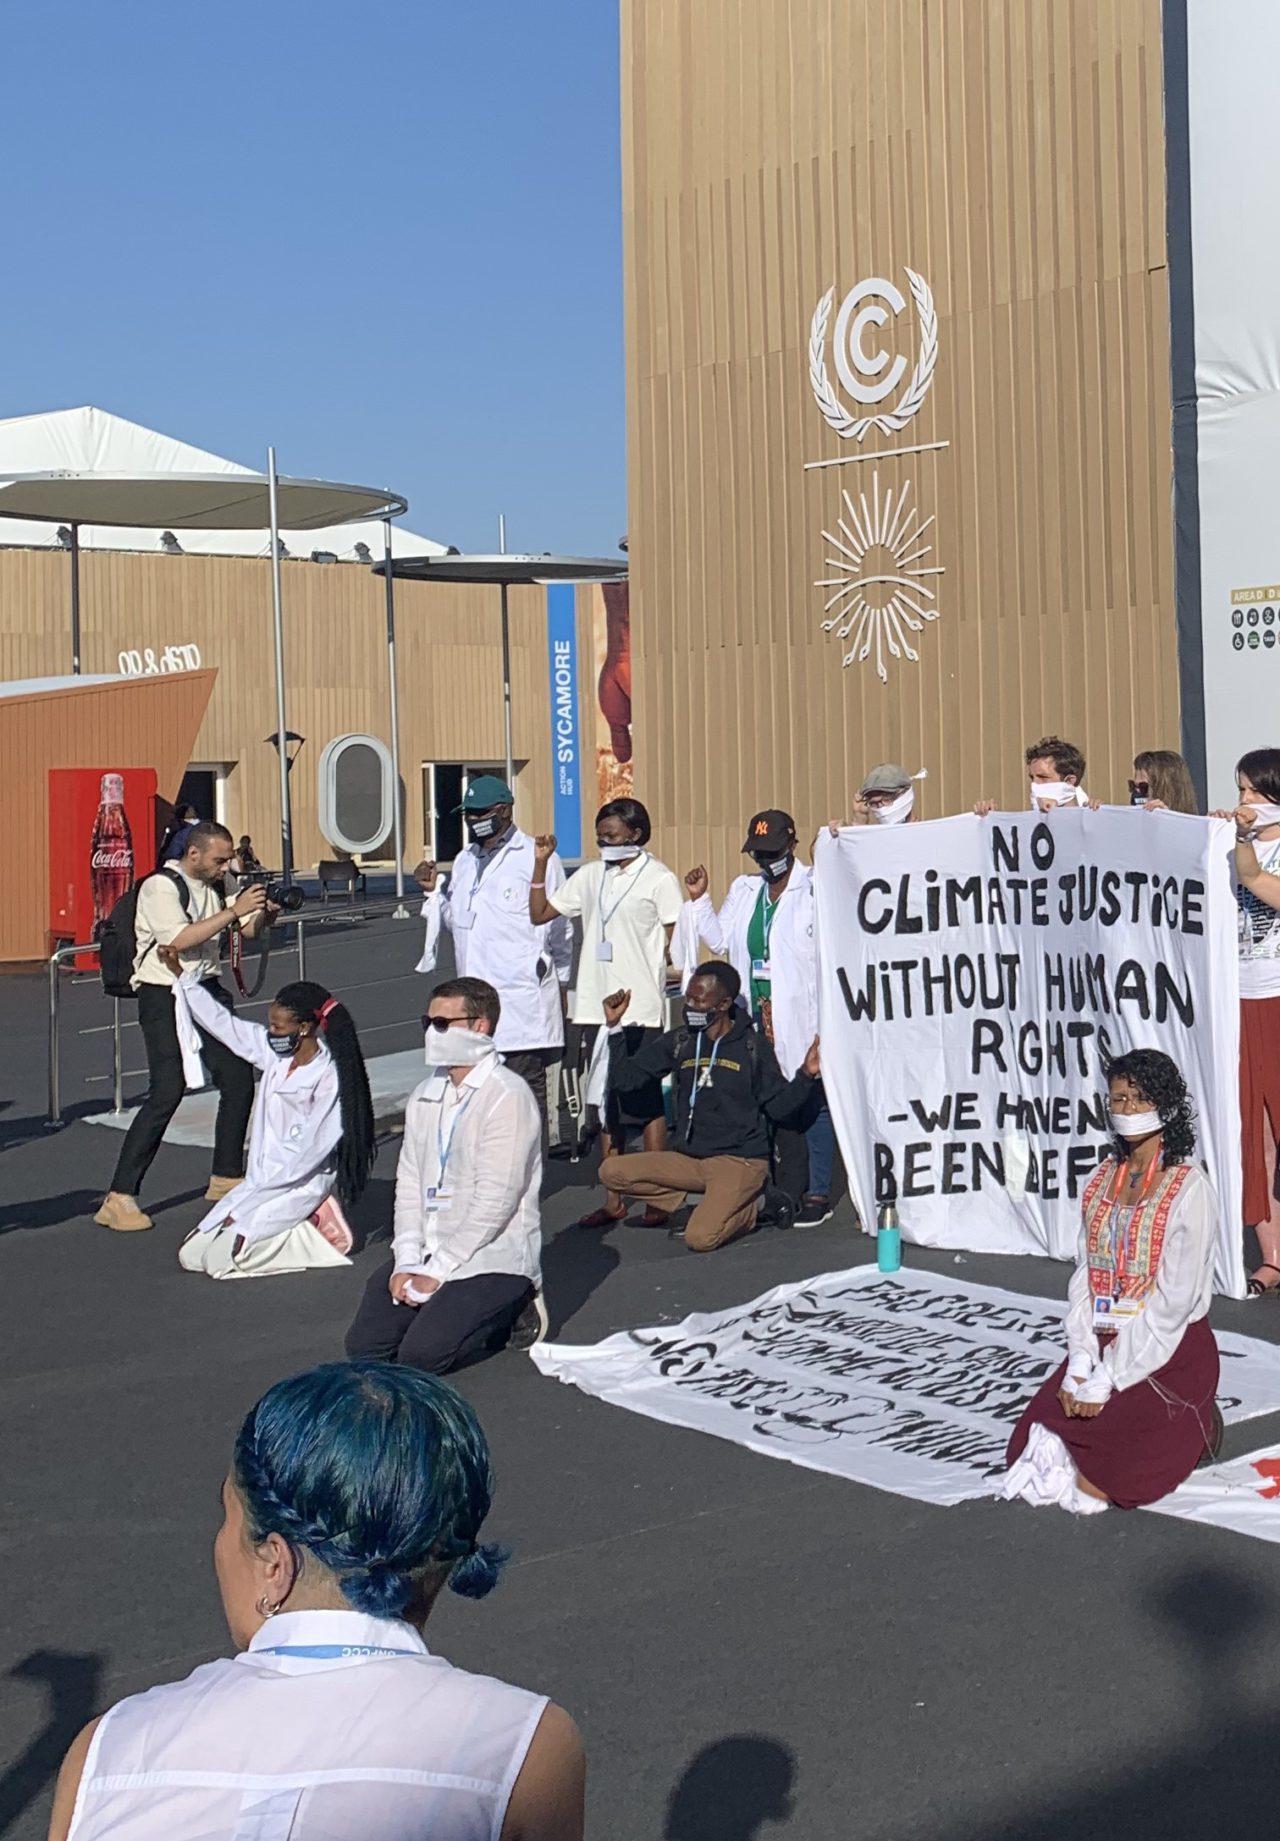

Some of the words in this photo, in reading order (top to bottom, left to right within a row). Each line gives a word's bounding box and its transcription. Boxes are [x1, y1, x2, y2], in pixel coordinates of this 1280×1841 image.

[1234, 592, 1256, 602] AREA
[1256, 590, 1263, 599] D
[1268, 589, 1275, 598] D
[554, 640, 573, 763] SYCAMORE
[991, 822, 1055, 872] NO
[1044, 952, 1195, 1028] HUMAN
[875, 1141, 1006, 1201] BEEN
